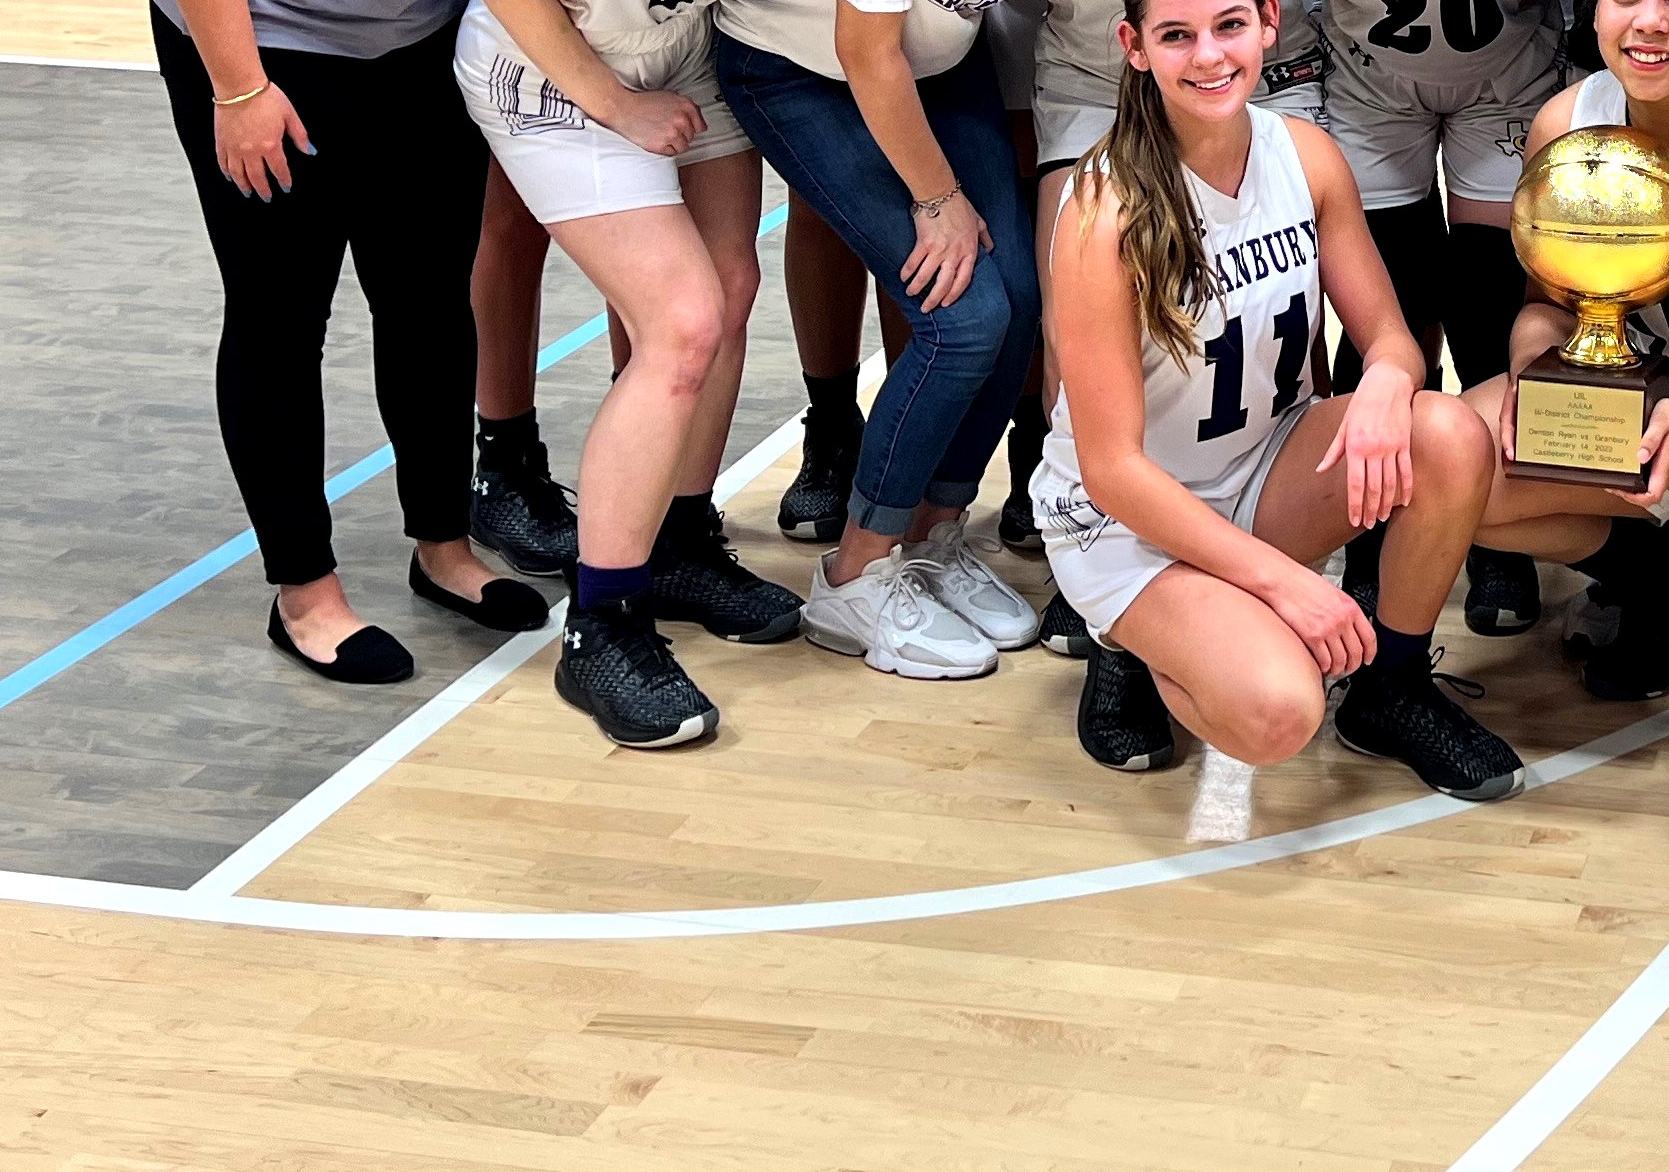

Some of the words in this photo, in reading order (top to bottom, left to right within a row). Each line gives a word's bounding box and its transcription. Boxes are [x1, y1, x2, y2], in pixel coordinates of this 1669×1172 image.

[1197, 291, 1310, 443] 11
[1594, 434, 1630, 446] Granbury
[1599, 454, 1624, 464] School
